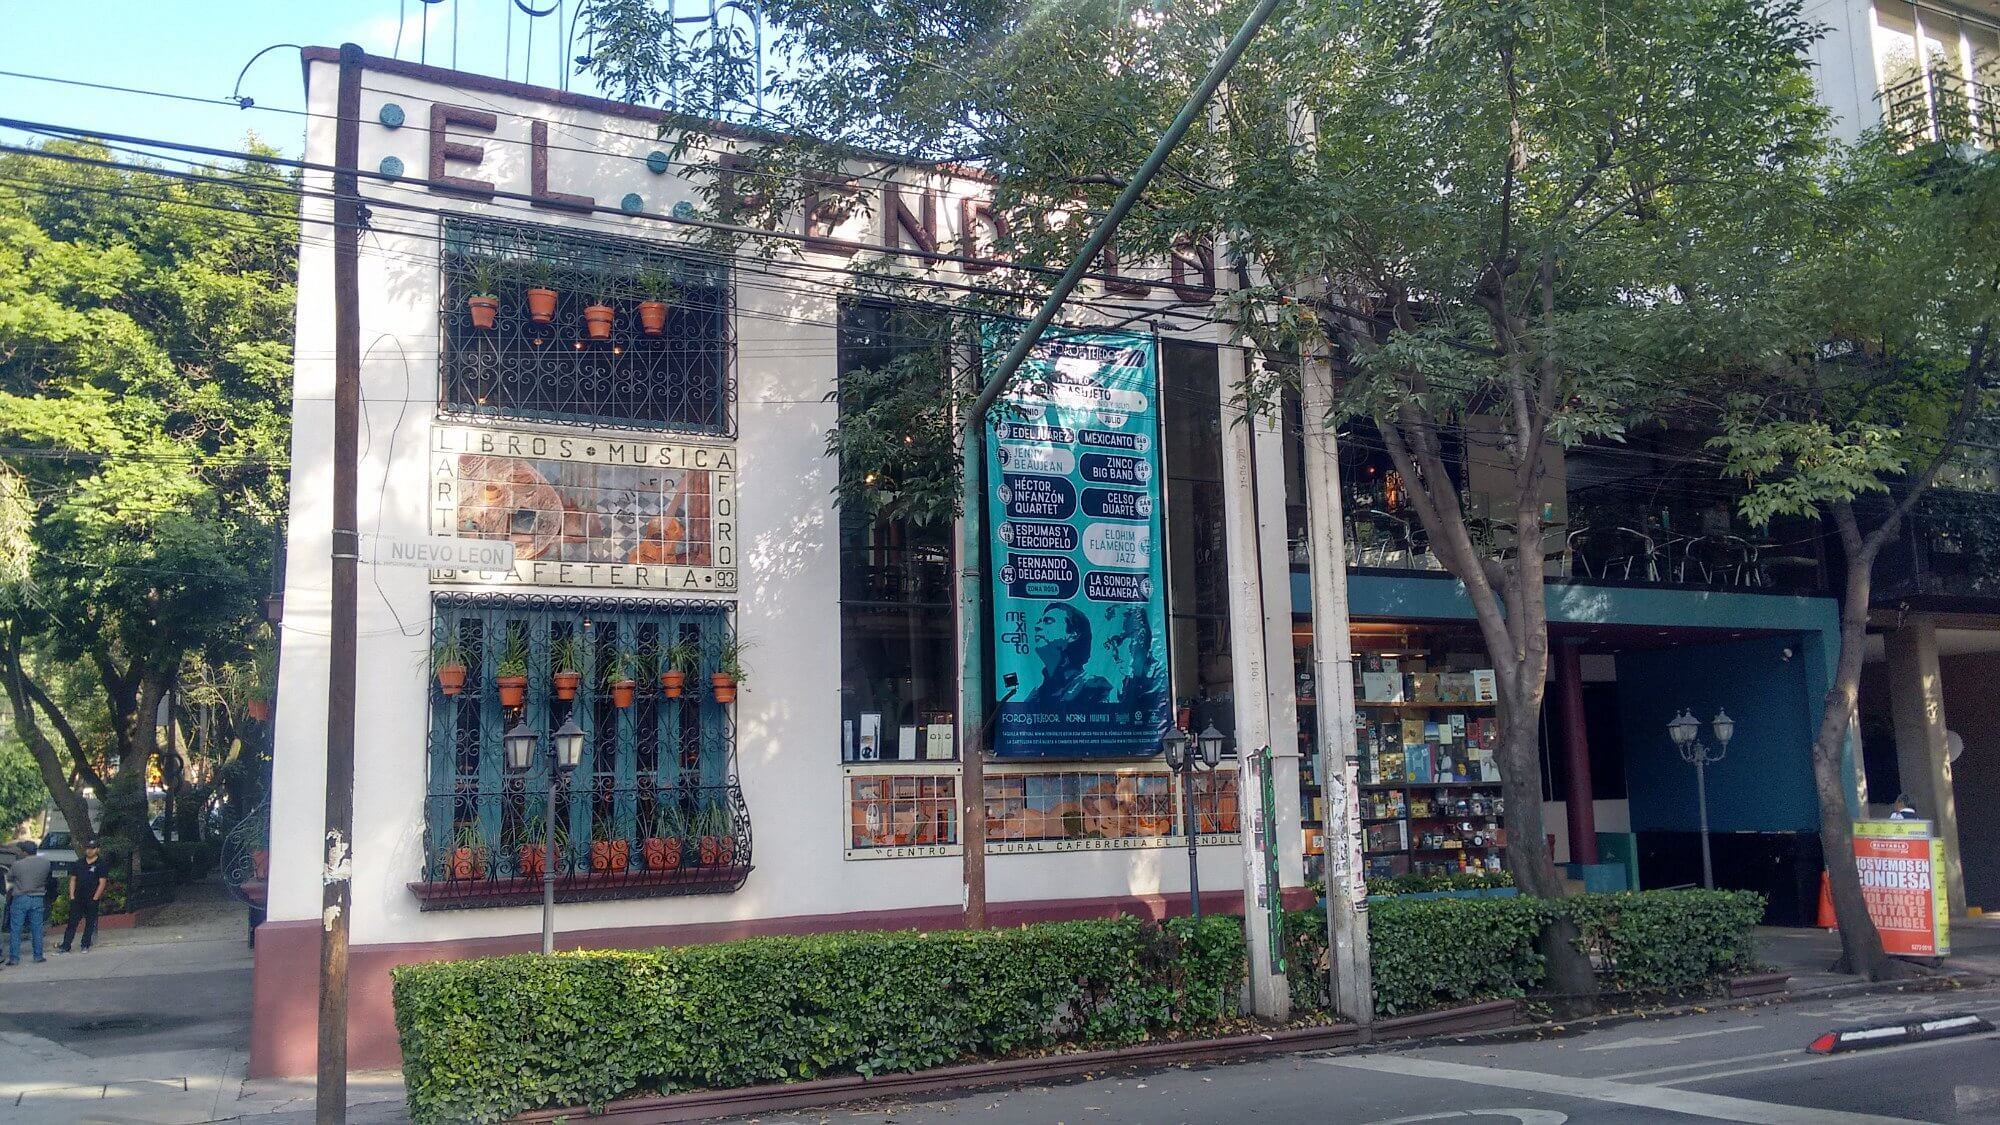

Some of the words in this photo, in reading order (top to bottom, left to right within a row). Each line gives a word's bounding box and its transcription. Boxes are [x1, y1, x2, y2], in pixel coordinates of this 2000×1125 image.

[429, 103, 595, 213] EL
[719, 154, 1215, 300] PENDLO
[1104, 414, 1121, 424] JULIO
[1084, 432, 1133, 446] MEXICANTO
[440, 429, 573, 458] LIBROS
[609, 443, 732, 469] MUSICA
[1014, 447, 1042, 458] JENNY
[1014, 459, 1063, 472] BEAUJEAN
[1107, 457, 1133, 469] ZINCO
[1092, 467, 1108, 478] BIG
[1110, 468, 1133, 480] BAND
[1014, 476, 1051, 492] HÉCTOR
[437, 457, 454, 537] ART
[1014, 490, 1064, 504] INFANZÓN
[1107, 492, 1134, 505] CELSO
[1015, 502, 1058, 515] QUARTET
[1102, 503, 1135, 516] DUARTE
[718, 475, 732, 565] FORO
[1015, 524, 1061, 537] ESPUMAS
[1063, 526, 1069, 538] Y
[1105, 529, 1135, 541] ELOHIM
[1015, 536, 1071, 549] TERCIOPELO
[1090, 539, 1136, 552] FLAMENCO
[392, 542, 453, 561] NUEVO
[458, 546, 504, 565] LEON
[1116, 553, 1136, 564] JAZZ
[1017, 556, 1067, 569] FERNANDO
[717, 571, 735, 587] 93
[1018, 568, 1073, 581] DELGADILLO
[1090, 574, 1102, 586] LA
[1103, 575, 1139, 588] SONORA
[1089, 585, 1140, 599] BALKANERA
[986, 842, 1043, 854] LTURAL
[1056, 839, 1147, 850] CAFEBRERIA
[1156, 838, 1171, 846] EL
[1874, 858, 1915, 873] VEMOS
[1915, 860, 1930, 873] EN
[1863, 891, 1926, 907] OLANCO
[1867, 903, 1907, 917] ANTA
[1909, 905, 1926, 918] FE
[1884, 915, 1927, 930] ANGEL
